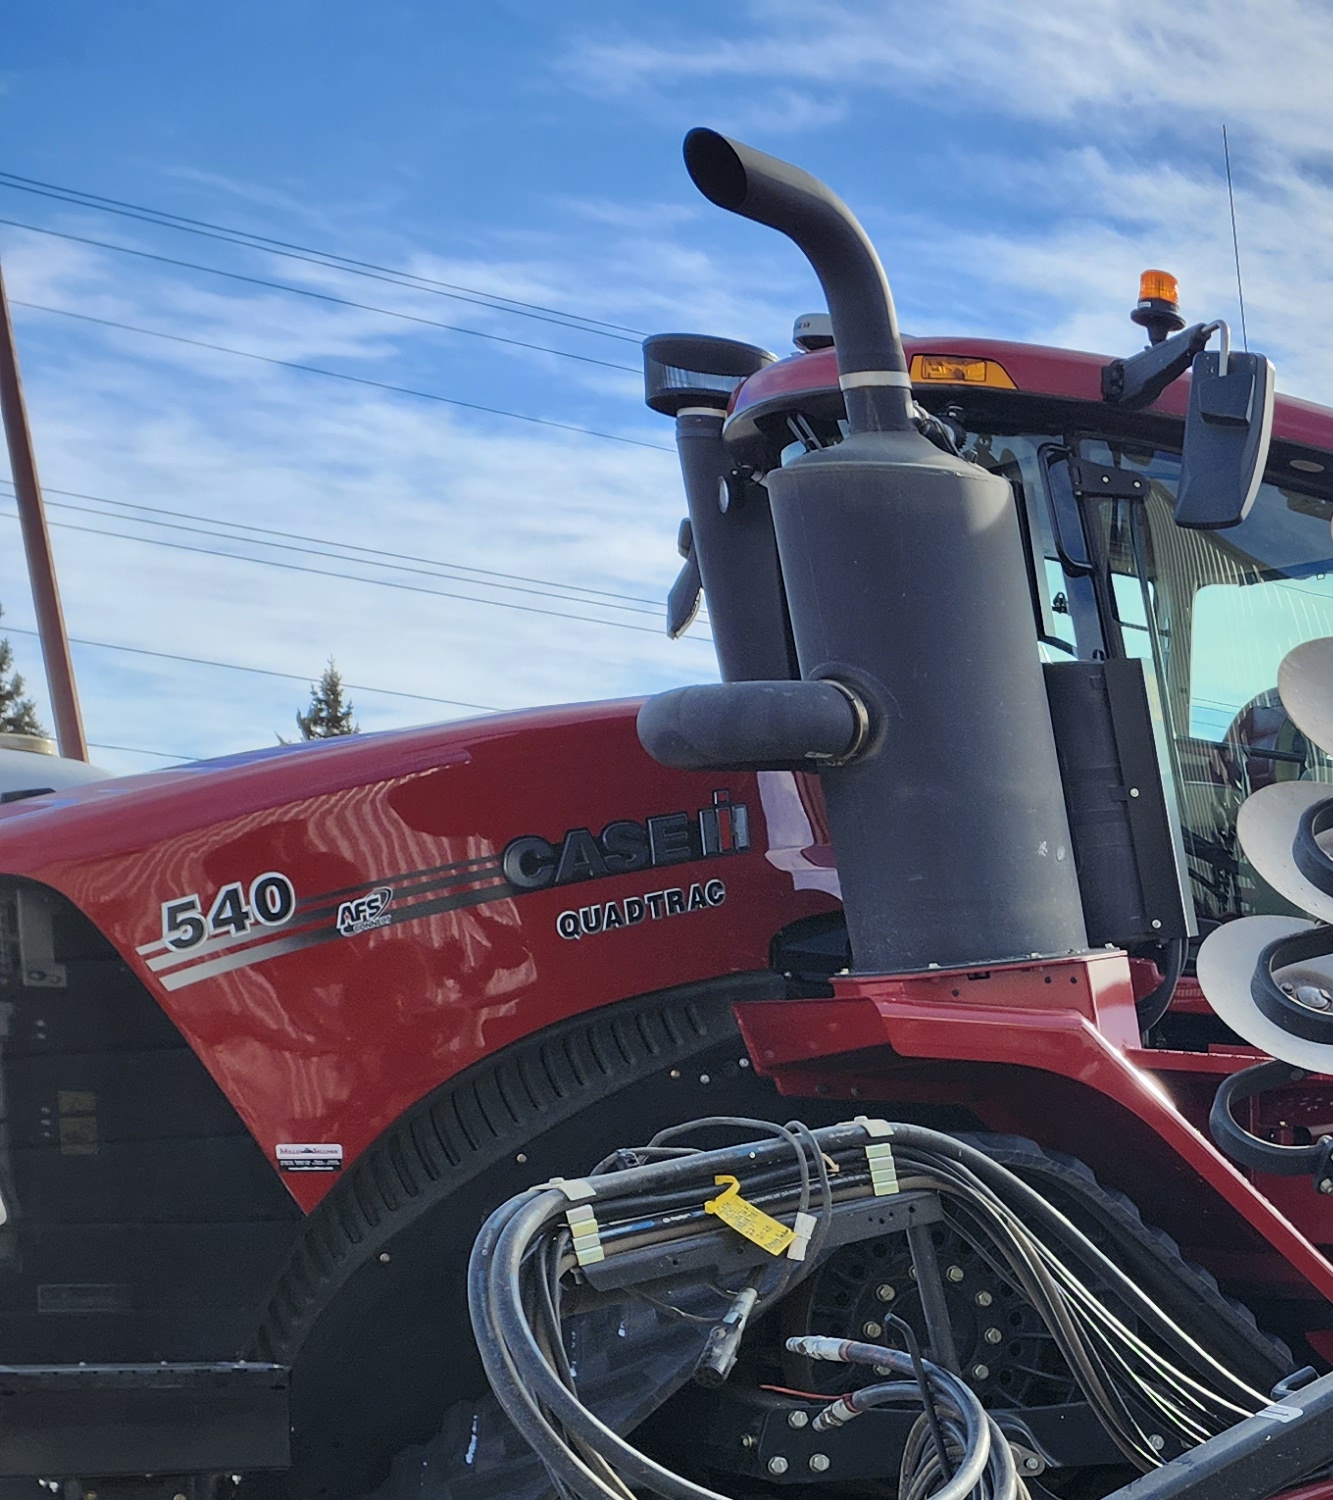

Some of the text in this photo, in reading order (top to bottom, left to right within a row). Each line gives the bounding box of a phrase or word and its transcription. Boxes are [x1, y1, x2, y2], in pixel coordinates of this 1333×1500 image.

[502, 812, 690, 889] CASE
[161, 872, 297, 952] 540
[338, 894, 382, 927] AFS
[556, 878, 726, 940] QUADTRAC
